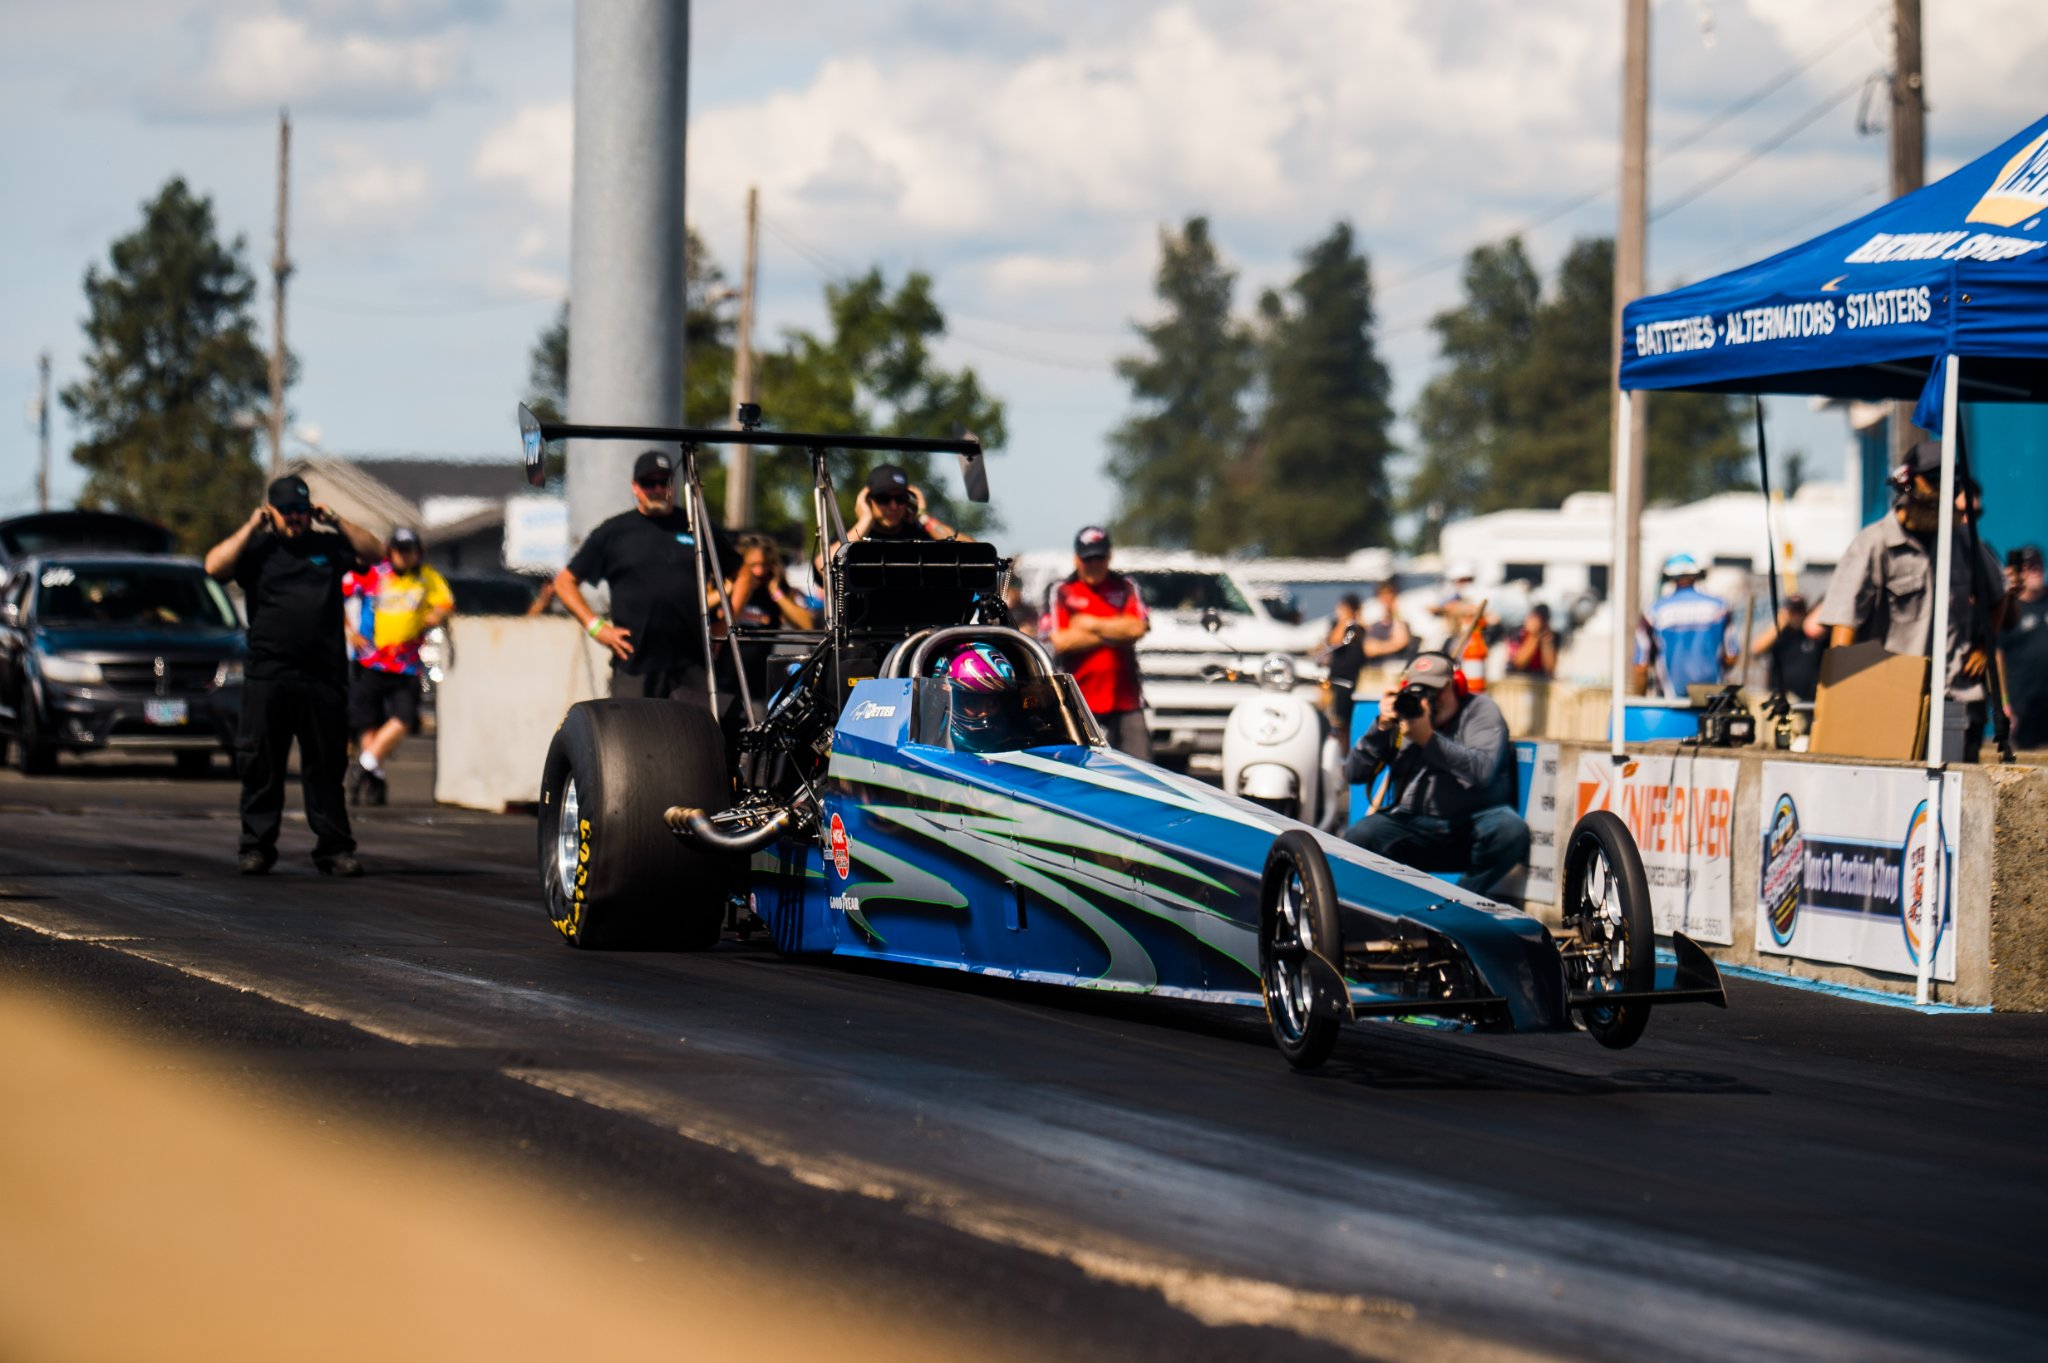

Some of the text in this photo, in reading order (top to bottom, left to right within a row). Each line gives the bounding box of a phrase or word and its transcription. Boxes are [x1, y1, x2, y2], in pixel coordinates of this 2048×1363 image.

[1635, 285, 1932, 357] BATTERIES ALTERNATORS STARTERS
[829, 892, 860, 914] GOODYEAR
[1803, 849, 1831, 892] Don's
[1831, 853, 1874, 897] Machine
[1874, 857, 1900, 904] Shop
